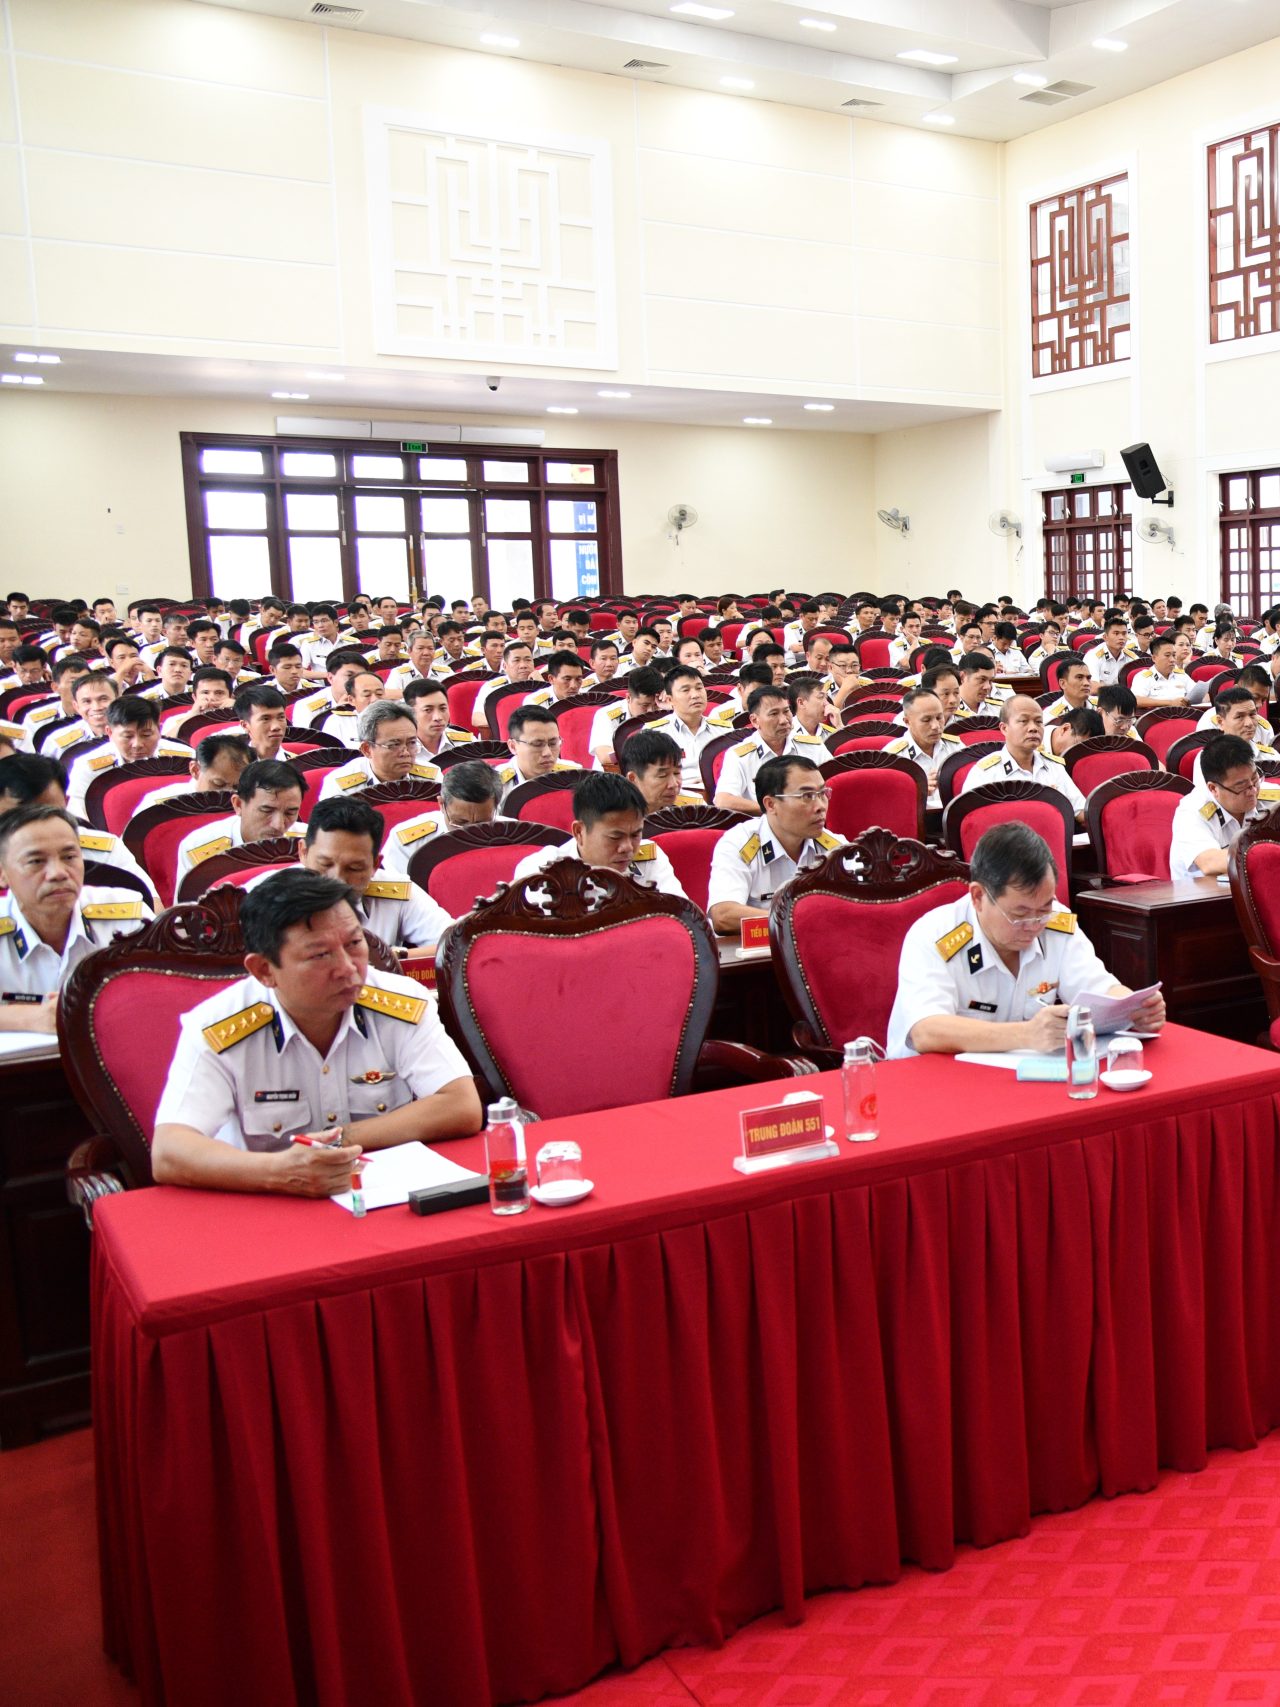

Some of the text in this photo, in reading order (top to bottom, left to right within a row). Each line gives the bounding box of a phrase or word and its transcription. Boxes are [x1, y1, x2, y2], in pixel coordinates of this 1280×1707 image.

[749, 1116, 820, 1143] TRUNG ĐOÀN 551
